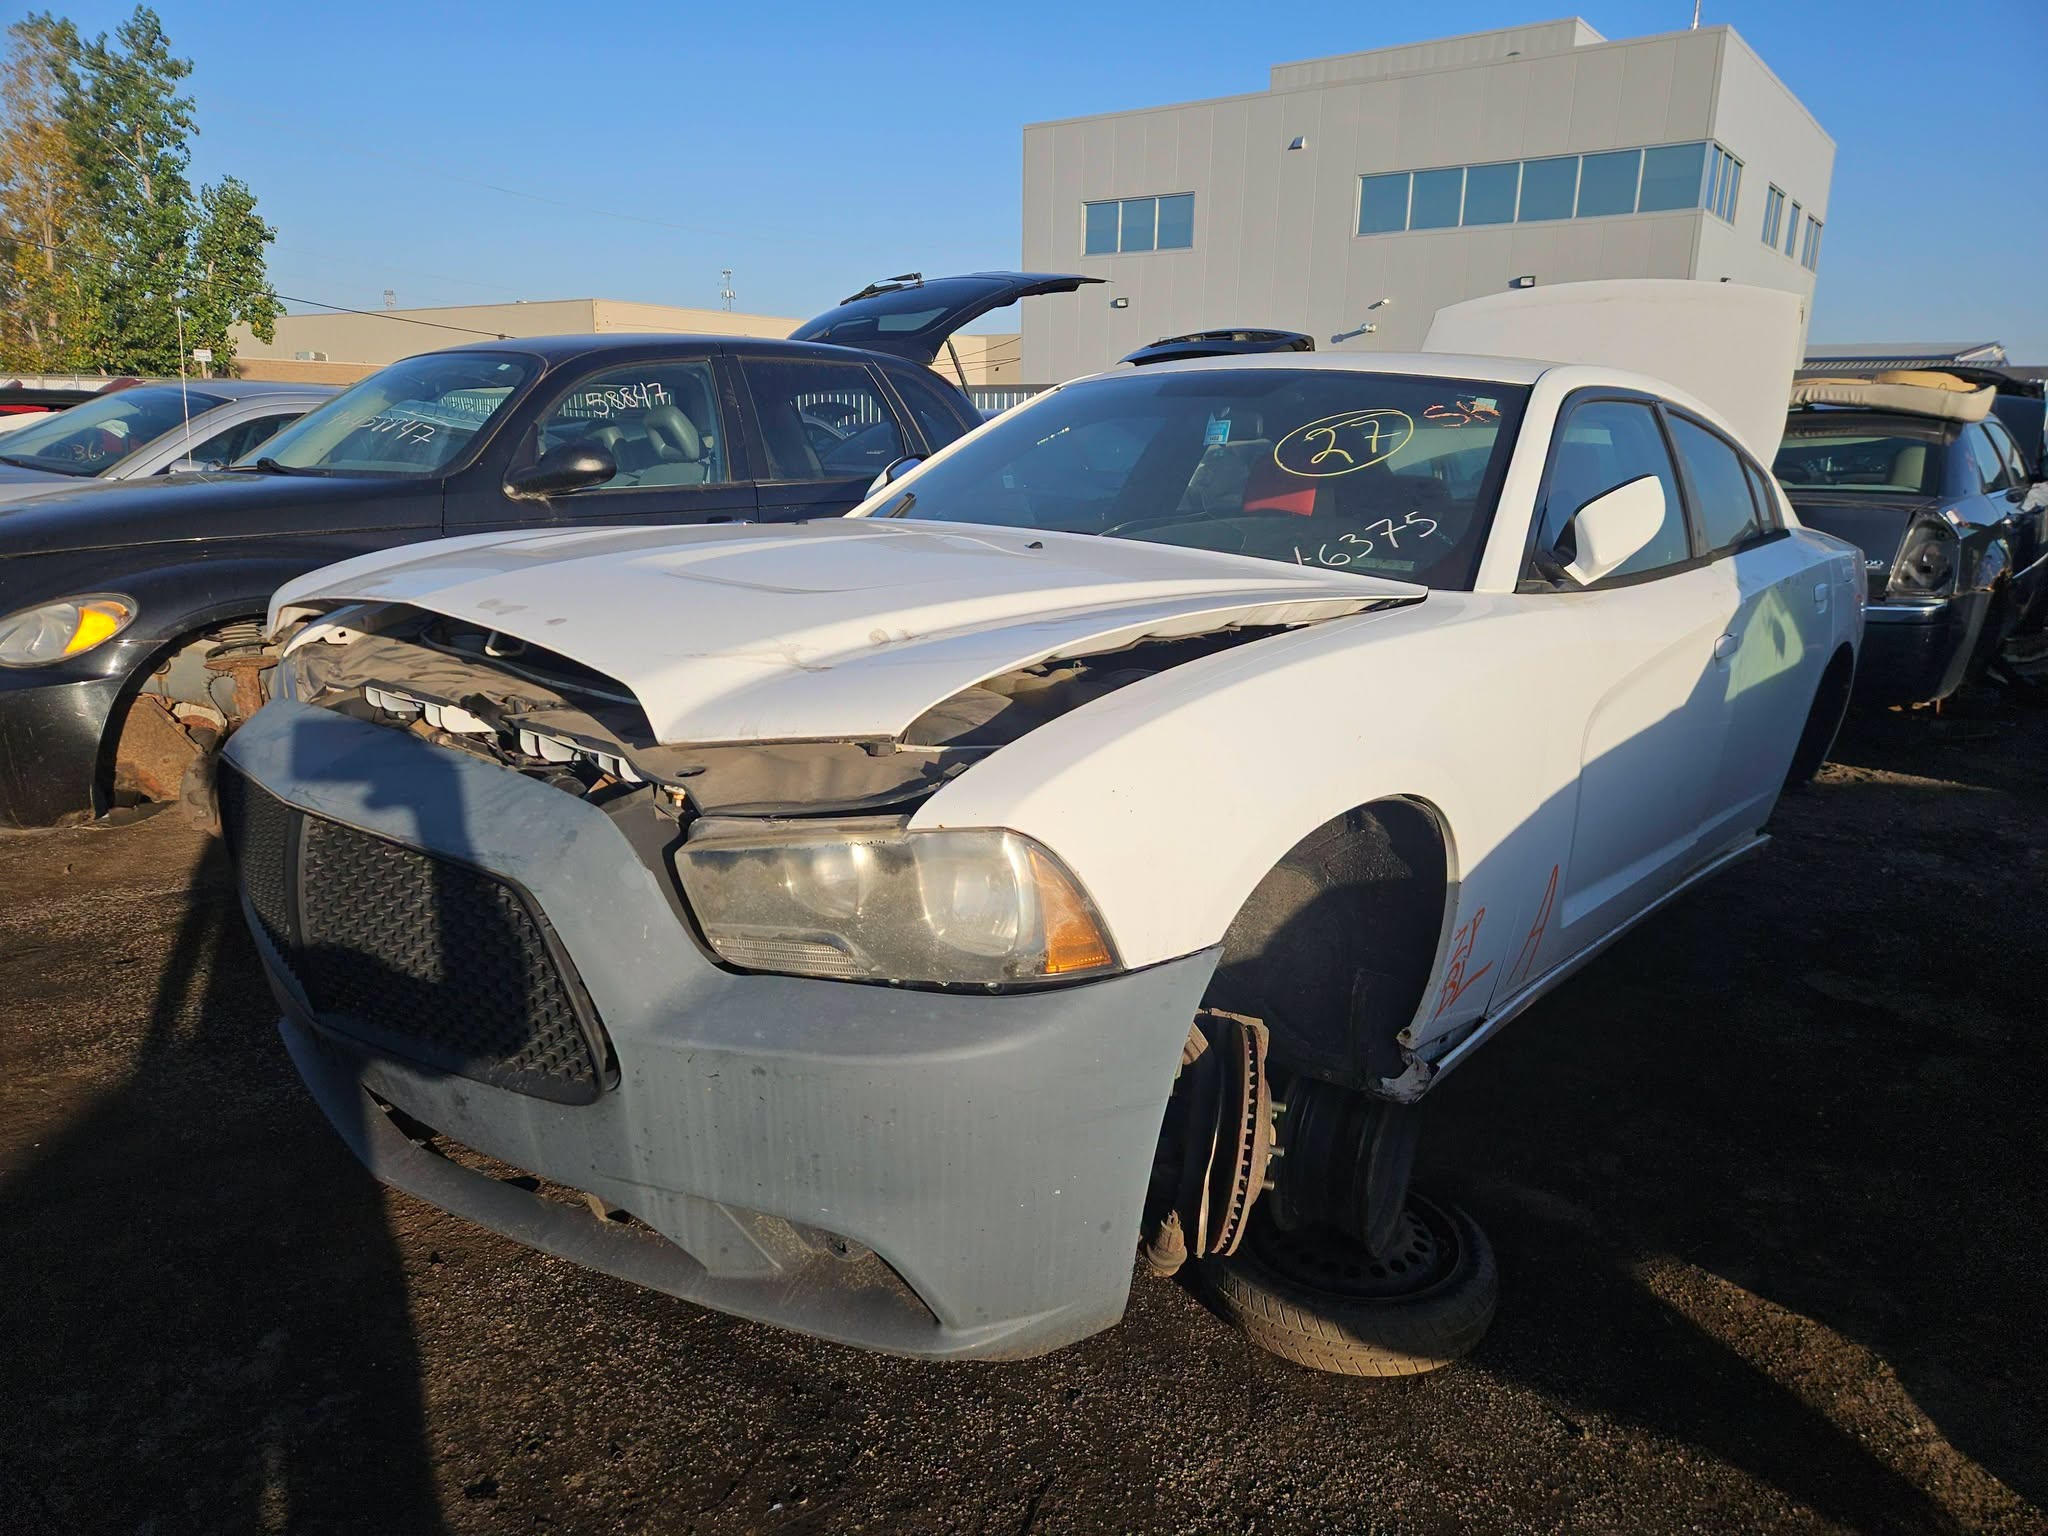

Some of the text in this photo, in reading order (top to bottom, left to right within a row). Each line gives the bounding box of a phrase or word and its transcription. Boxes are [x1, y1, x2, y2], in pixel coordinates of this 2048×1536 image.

[586, 383, 668, 416] 58847
[1304, 418, 1402, 464] 27
[1506, 863, 1559, 985] A
